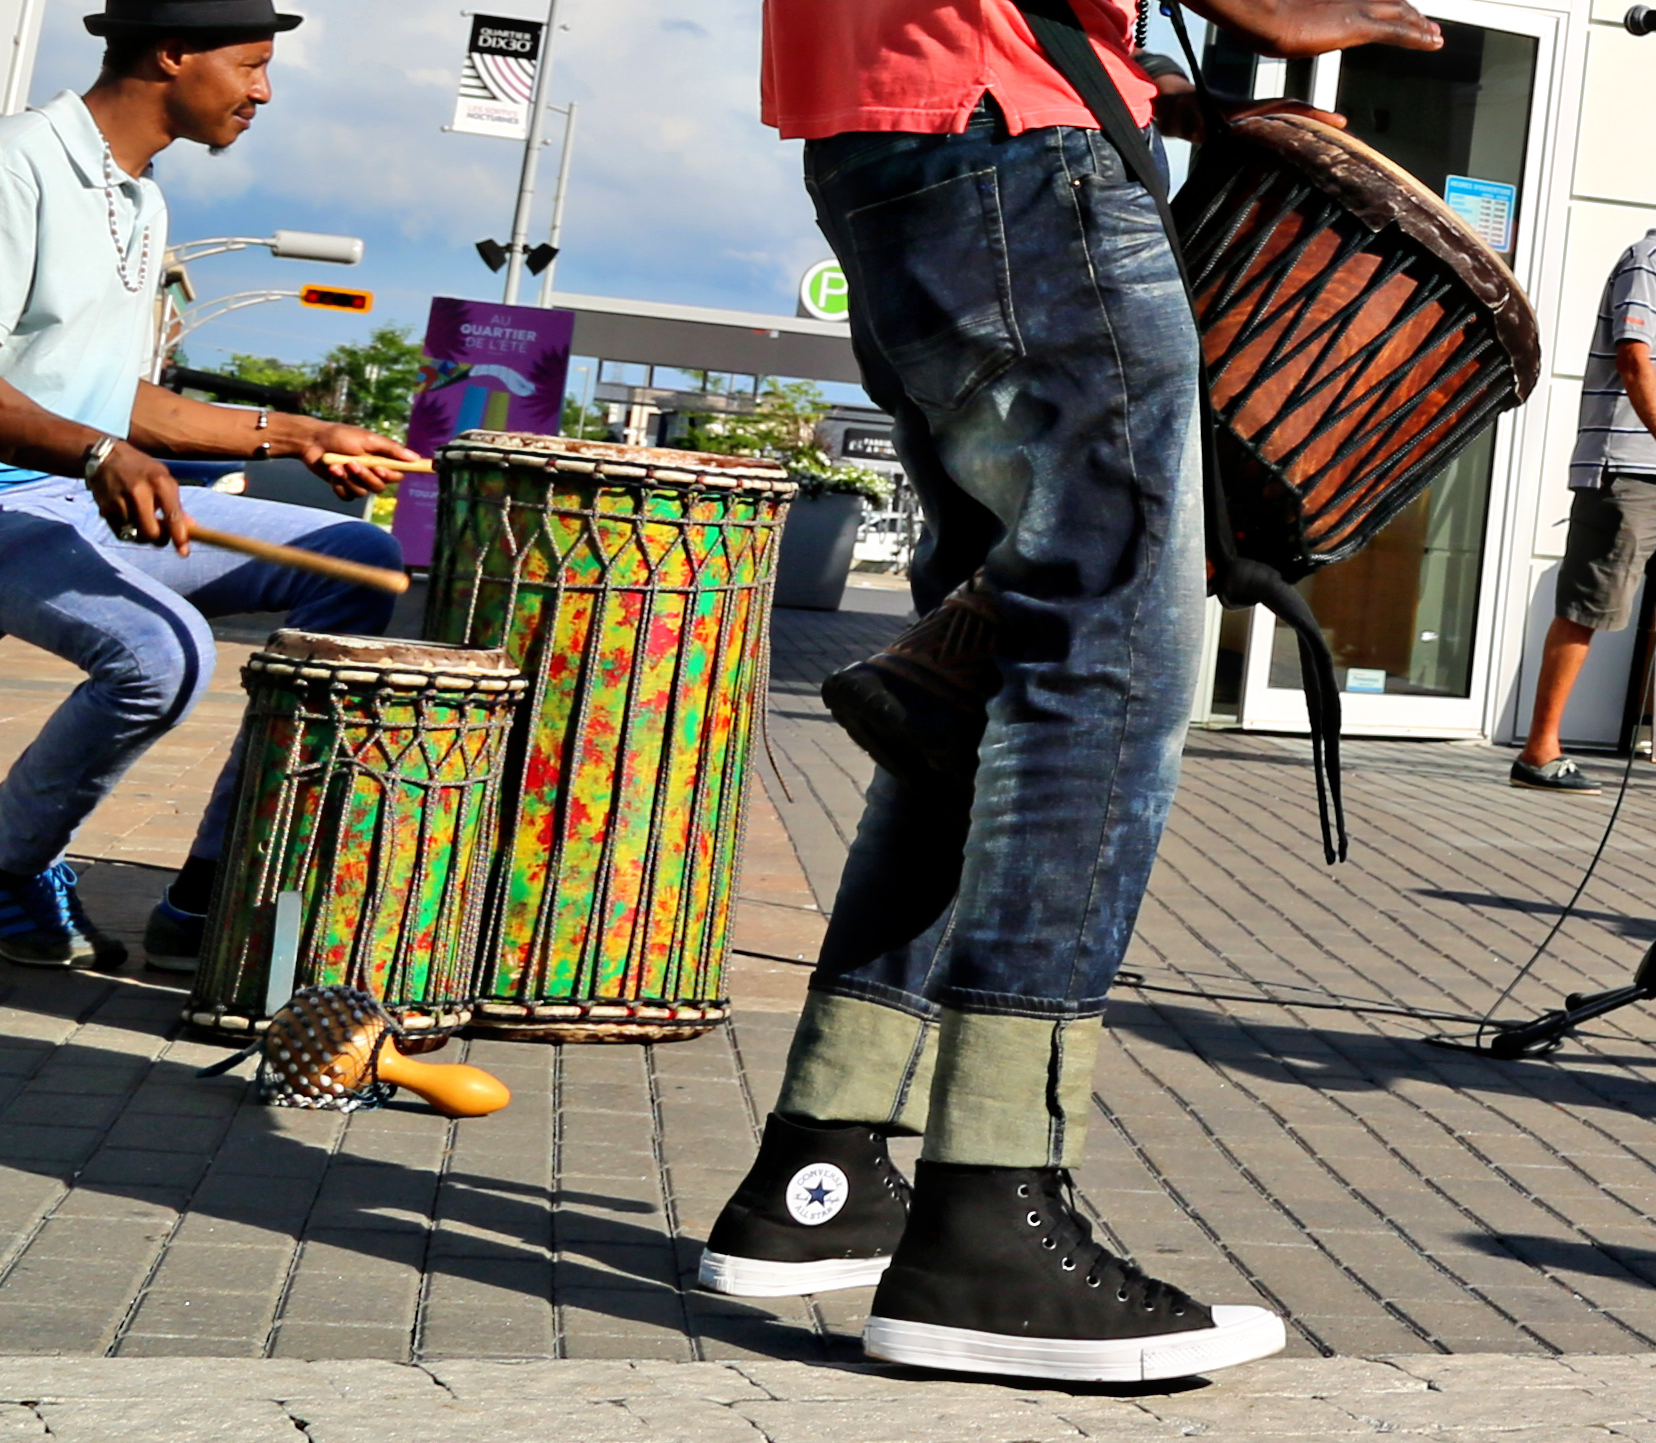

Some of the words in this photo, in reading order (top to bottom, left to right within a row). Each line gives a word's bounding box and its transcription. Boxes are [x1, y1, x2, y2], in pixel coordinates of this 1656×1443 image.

[480, 27, 532, 40] QUARTIER
[818, 270, 849, 308] P
[460, 323, 537, 342] QUARTIER
